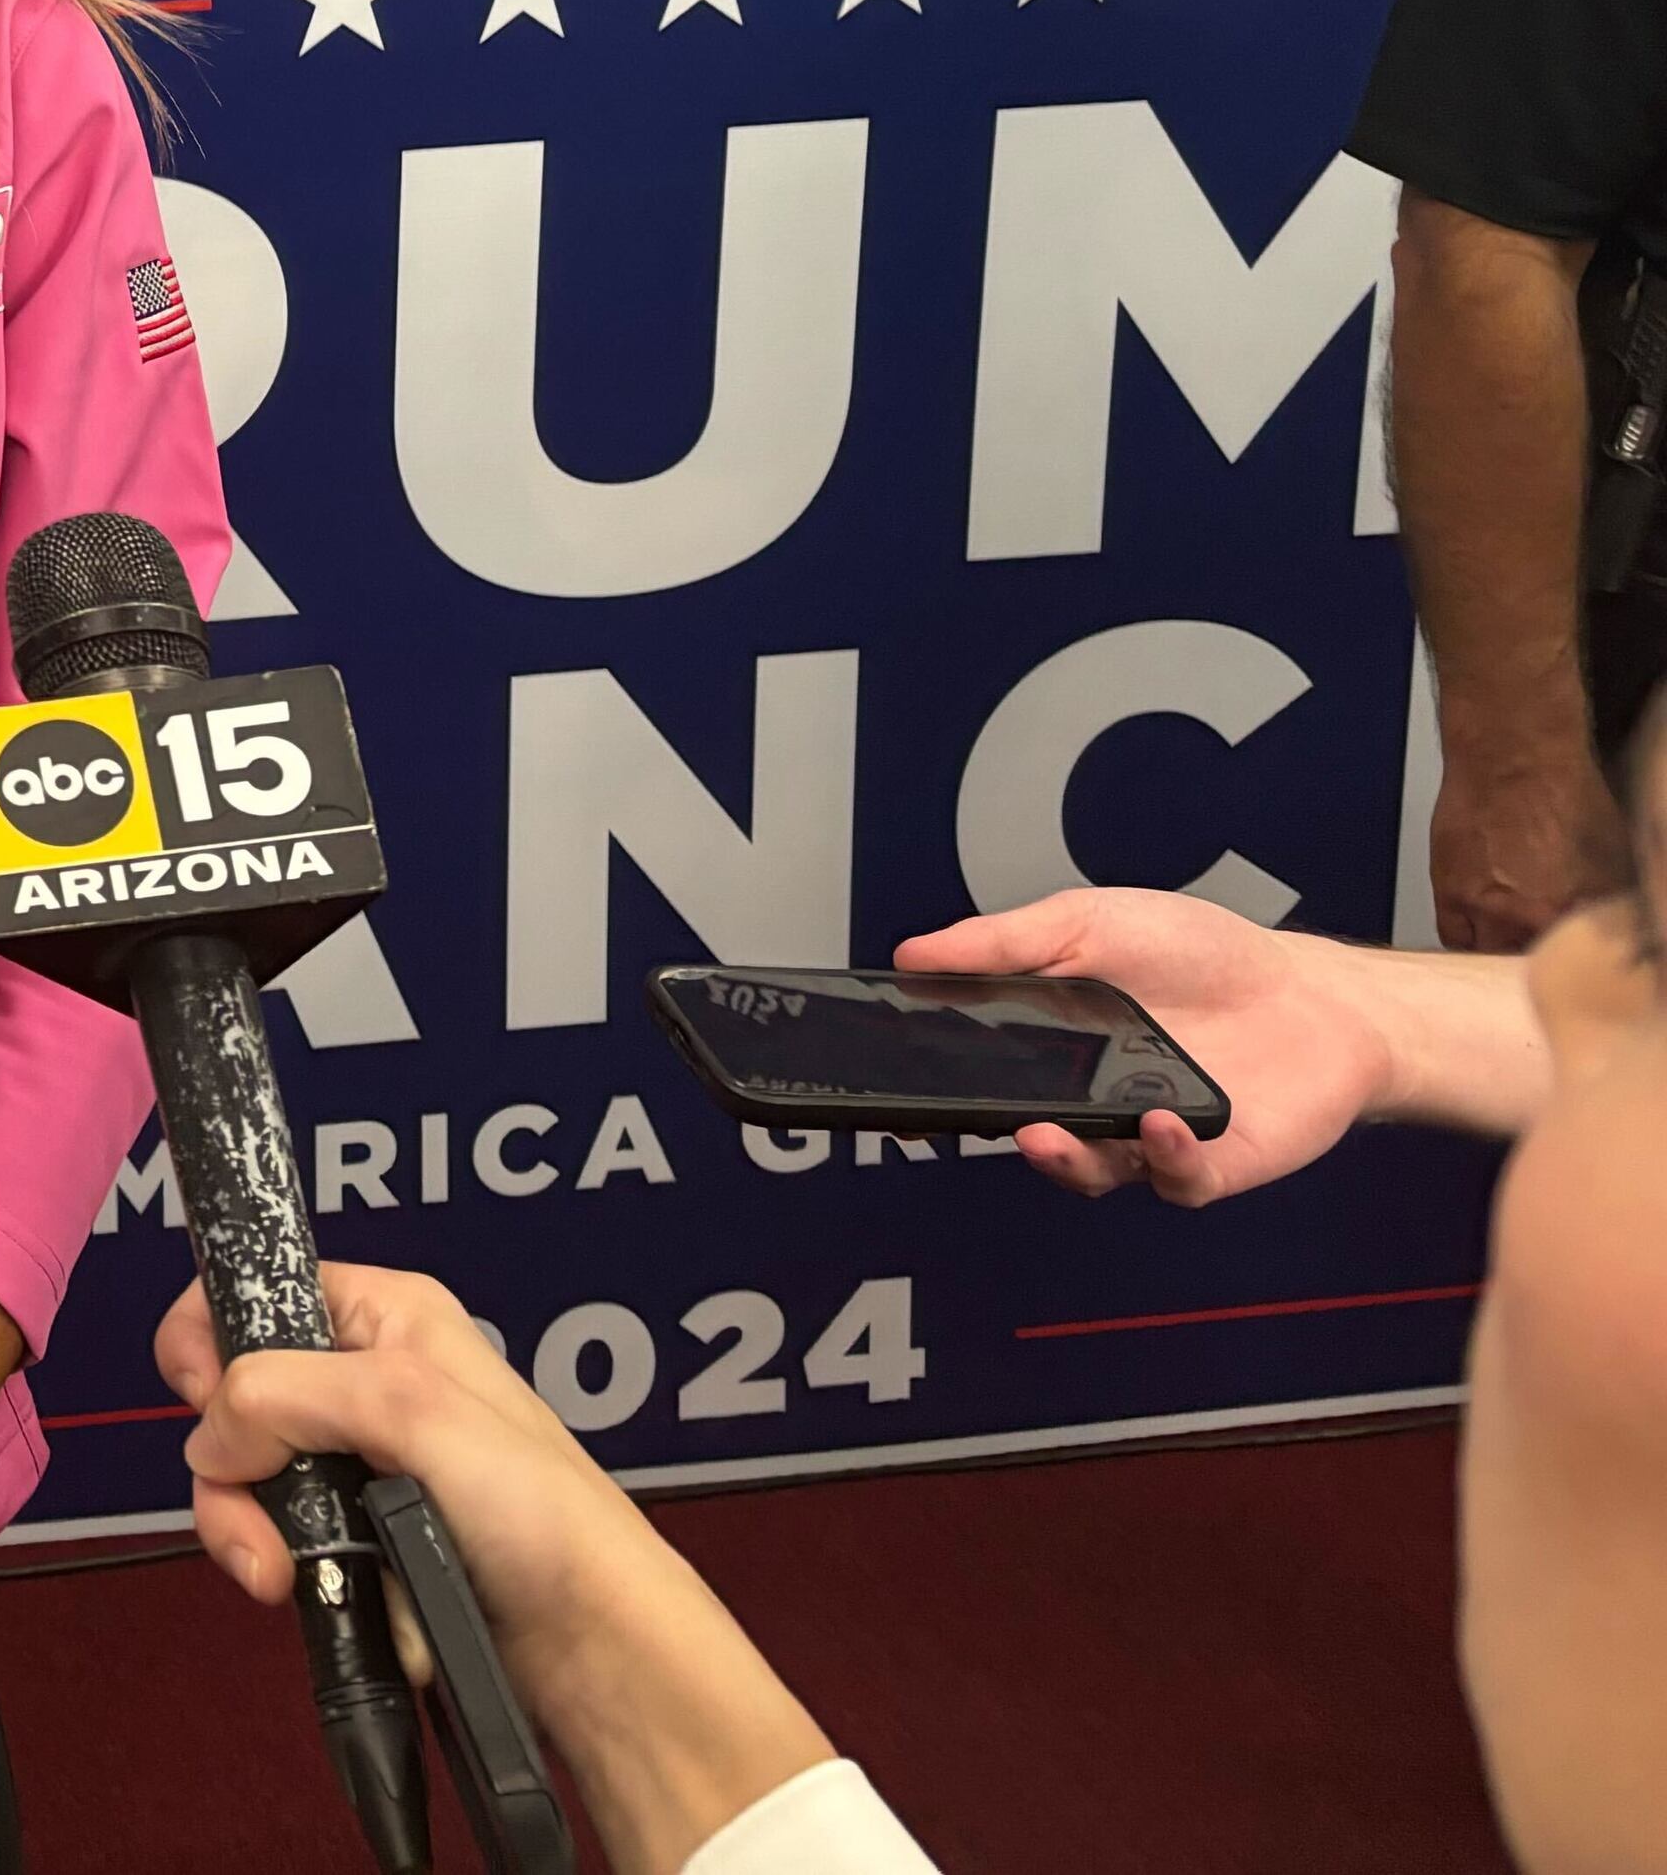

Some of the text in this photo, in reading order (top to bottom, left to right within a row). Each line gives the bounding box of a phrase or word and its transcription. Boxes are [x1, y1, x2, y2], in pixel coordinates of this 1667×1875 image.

[1, 700, 313, 824] abc 15
[13, 839, 335, 915] ARIZONA
[92, 1095, 677, 1235] MRICA
[467, 1276, 927, 1434] 024
